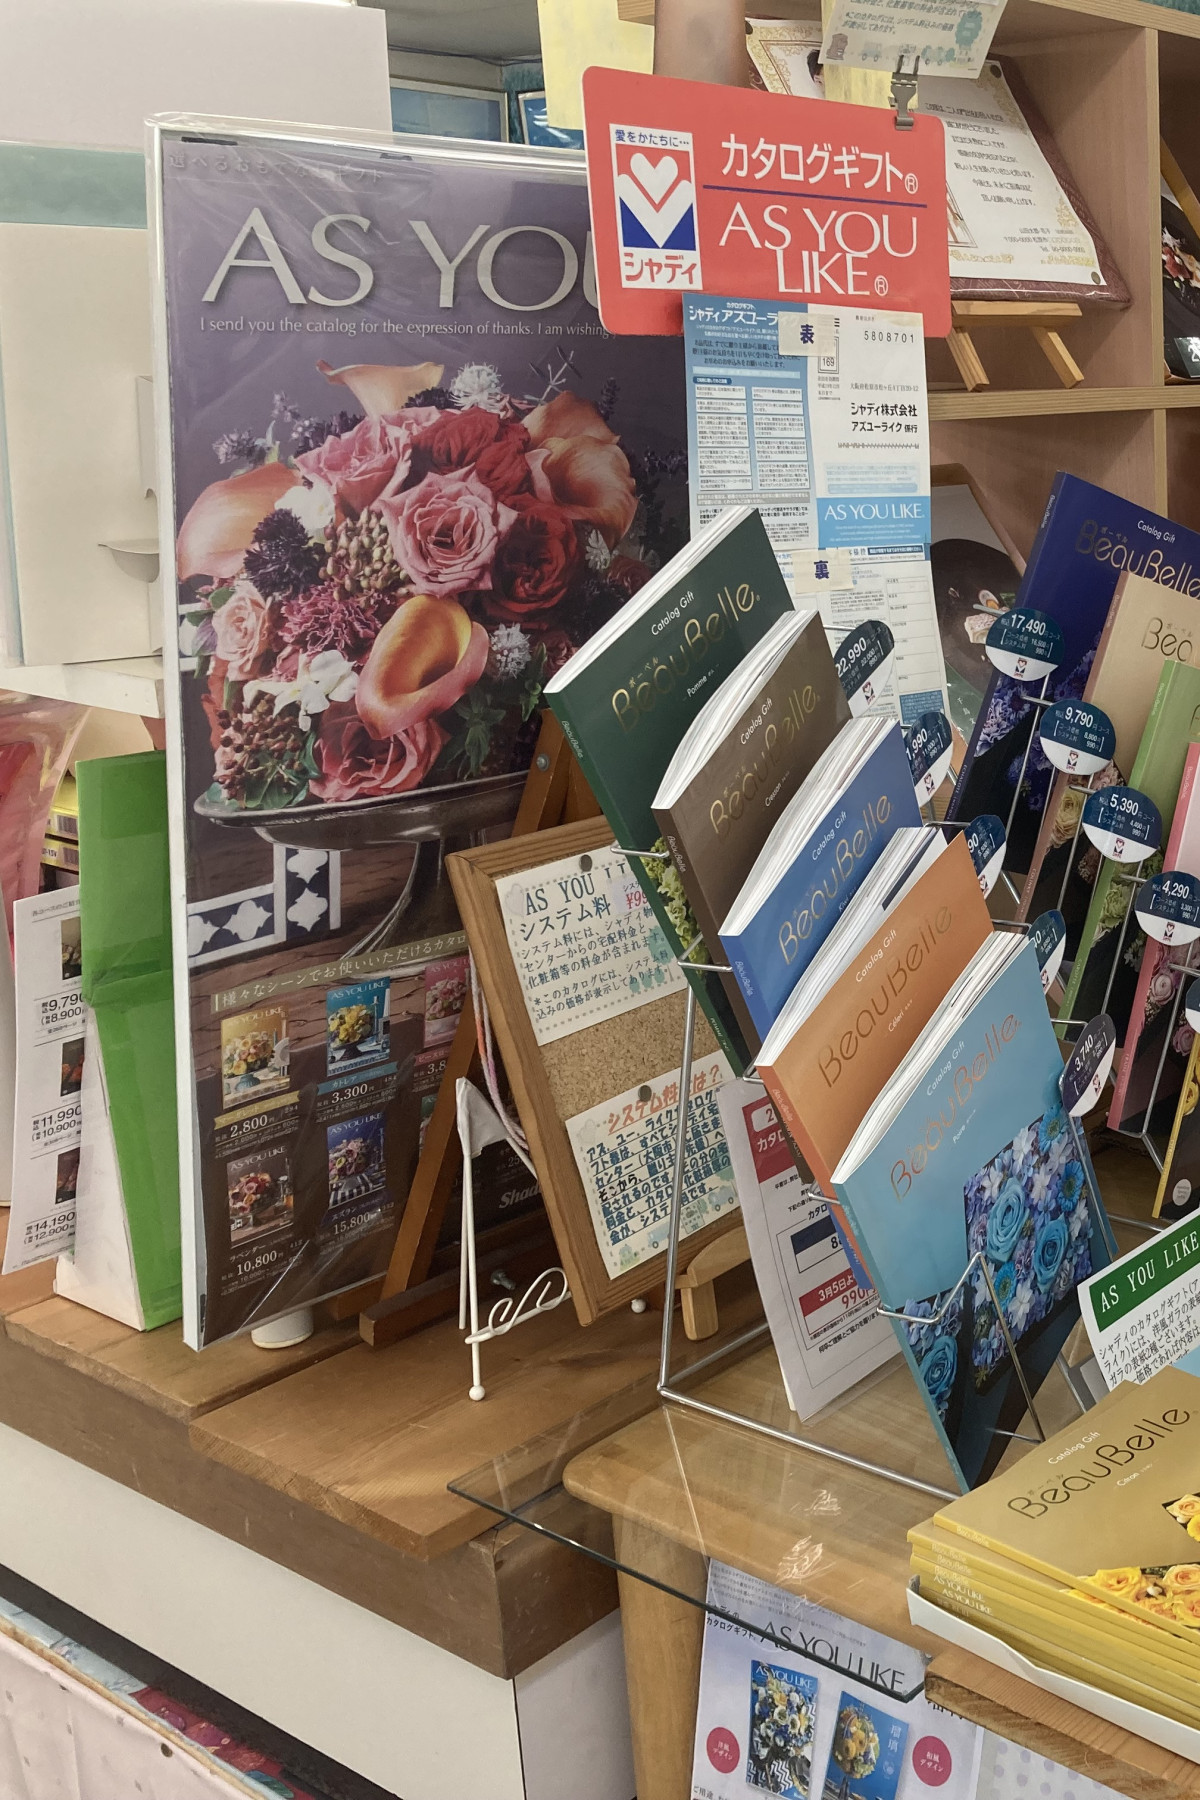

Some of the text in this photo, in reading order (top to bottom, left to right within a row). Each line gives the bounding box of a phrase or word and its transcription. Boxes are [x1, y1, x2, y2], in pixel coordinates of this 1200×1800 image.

[719, 201, 918, 259] AS YOU
[200, 207, 378, 306] AS
[622, 252, 698, 286] シャディ
[208, 316, 244, 333] send
[248, 320, 275, 337] you
[278, 317, 303, 334] the
[306, 318, 357, 338] catalog
[359, 318, 381, 335] for
[382, 319, 404, 335] the
[406, 321, 474, 340] expression
[476, 320, 490, 335] of
[492, 320, 533, 337] thanks.
[544, 326, 564, 337] am
[567, 322, 610, 341] wishing
[799, 323, 815, 345] 表
[863, 330, 916, 344] 5808701
[821, 357, 835, 367] 169
[850, 402, 918, 418] シャディ株式会社
[824, 502, 924, 522] AS YOU LIKE
[1137, 519, 1176, 544] Catalog Gift
[812, 559, 830, 580] 裏
[651, 591, 696, 636] Catalog Gift
[1011, 613, 1047, 636] 17,490
[611, 583, 755, 733] BeauBelle
[686, 674, 709, 699] Pomme
[740, 698, 774, 746] Catalog Gift
[1065, 706, 1094, 728] 9,790
[906, 728, 928, 761] 1,990
[1109, 793, 1139, 815] 5,390
[811, 811, 847, 861] Catalog Gift
[778, 794, 892, 965] BeauBelle
[1162, 880, 1190, 900] 4,290
[525, 873, 596, 917] AS YOU
[519, 893, 611, 943] システム料
[855, 929, 898, 983] Catalog Gift
[818, 905, 952, 1088] BeauBelle
[1075, 1034, 1094, 1071] 3,740
[926, 1040, 965, 1096] Catalog Gift
[331, 1083, 368, 1104] 3,300
[890, 1014, 1017, 1200] BeauBelle
[230, 1114, 268, 1138] 2,800
[333, 1212, 371, 1235] 15,800
[237, 1249, 278, 1276] 10,800
[1101, 1230, 1200, 1314] AS YOU LIKE
[1047, 1429, 1101, 1466] Catalog Gift
[1006, 1404, 1192, 1520] BeauBelle
[1115, 1470, 1141, 1489] Citron
[933, 1575, 985, 1602] AS YOU LIKE
[942, 1588, 993, 1616] AS YOU LIKE
[756, 1665, 814, 1690] AS YOU LIKE
[919, 1756, 945, 1773] デザイン
